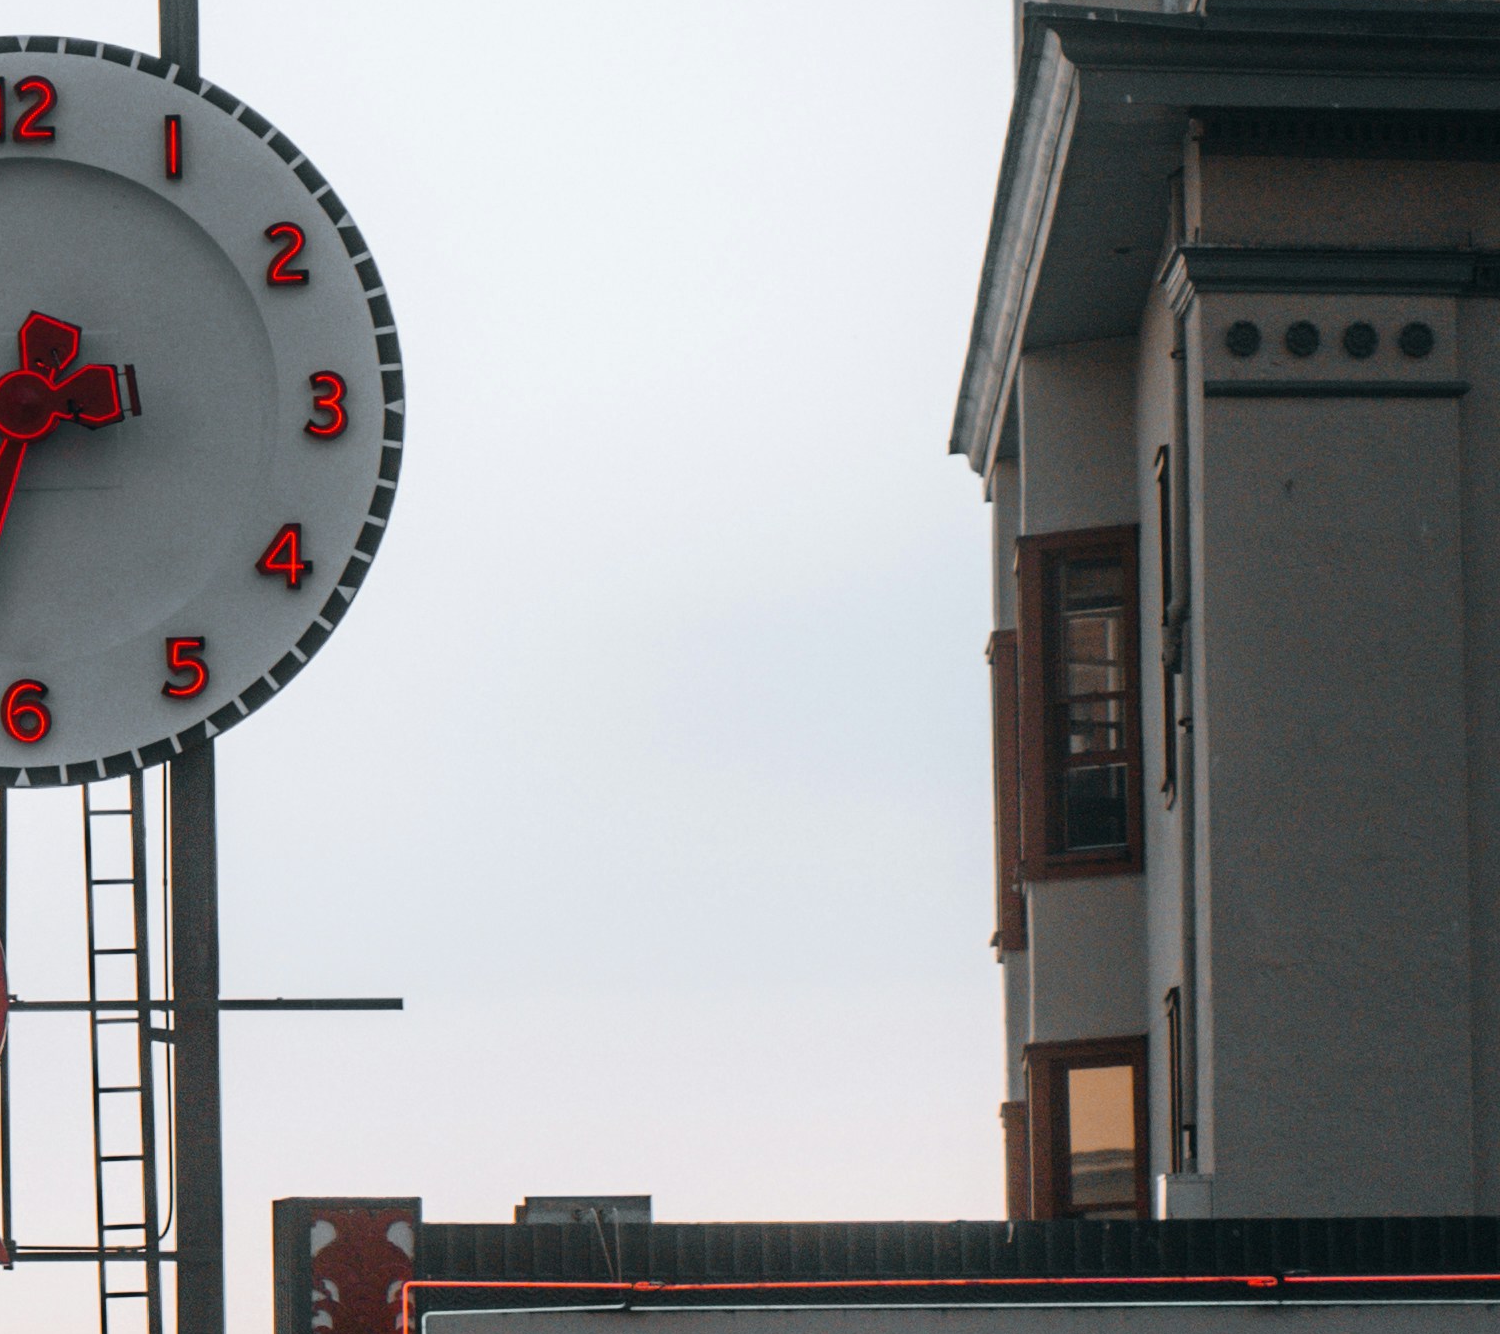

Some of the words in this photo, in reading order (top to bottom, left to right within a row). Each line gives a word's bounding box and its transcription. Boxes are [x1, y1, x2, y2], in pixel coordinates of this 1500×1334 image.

[164, 113, 183, 180] 1
[264, 222, 309, 285] 2
[304, 370, 349, 440] 3
[254, 522, 313, 589] 4
[161, 636, 210, 700] 5
[0, 678, 52, 744] 6
